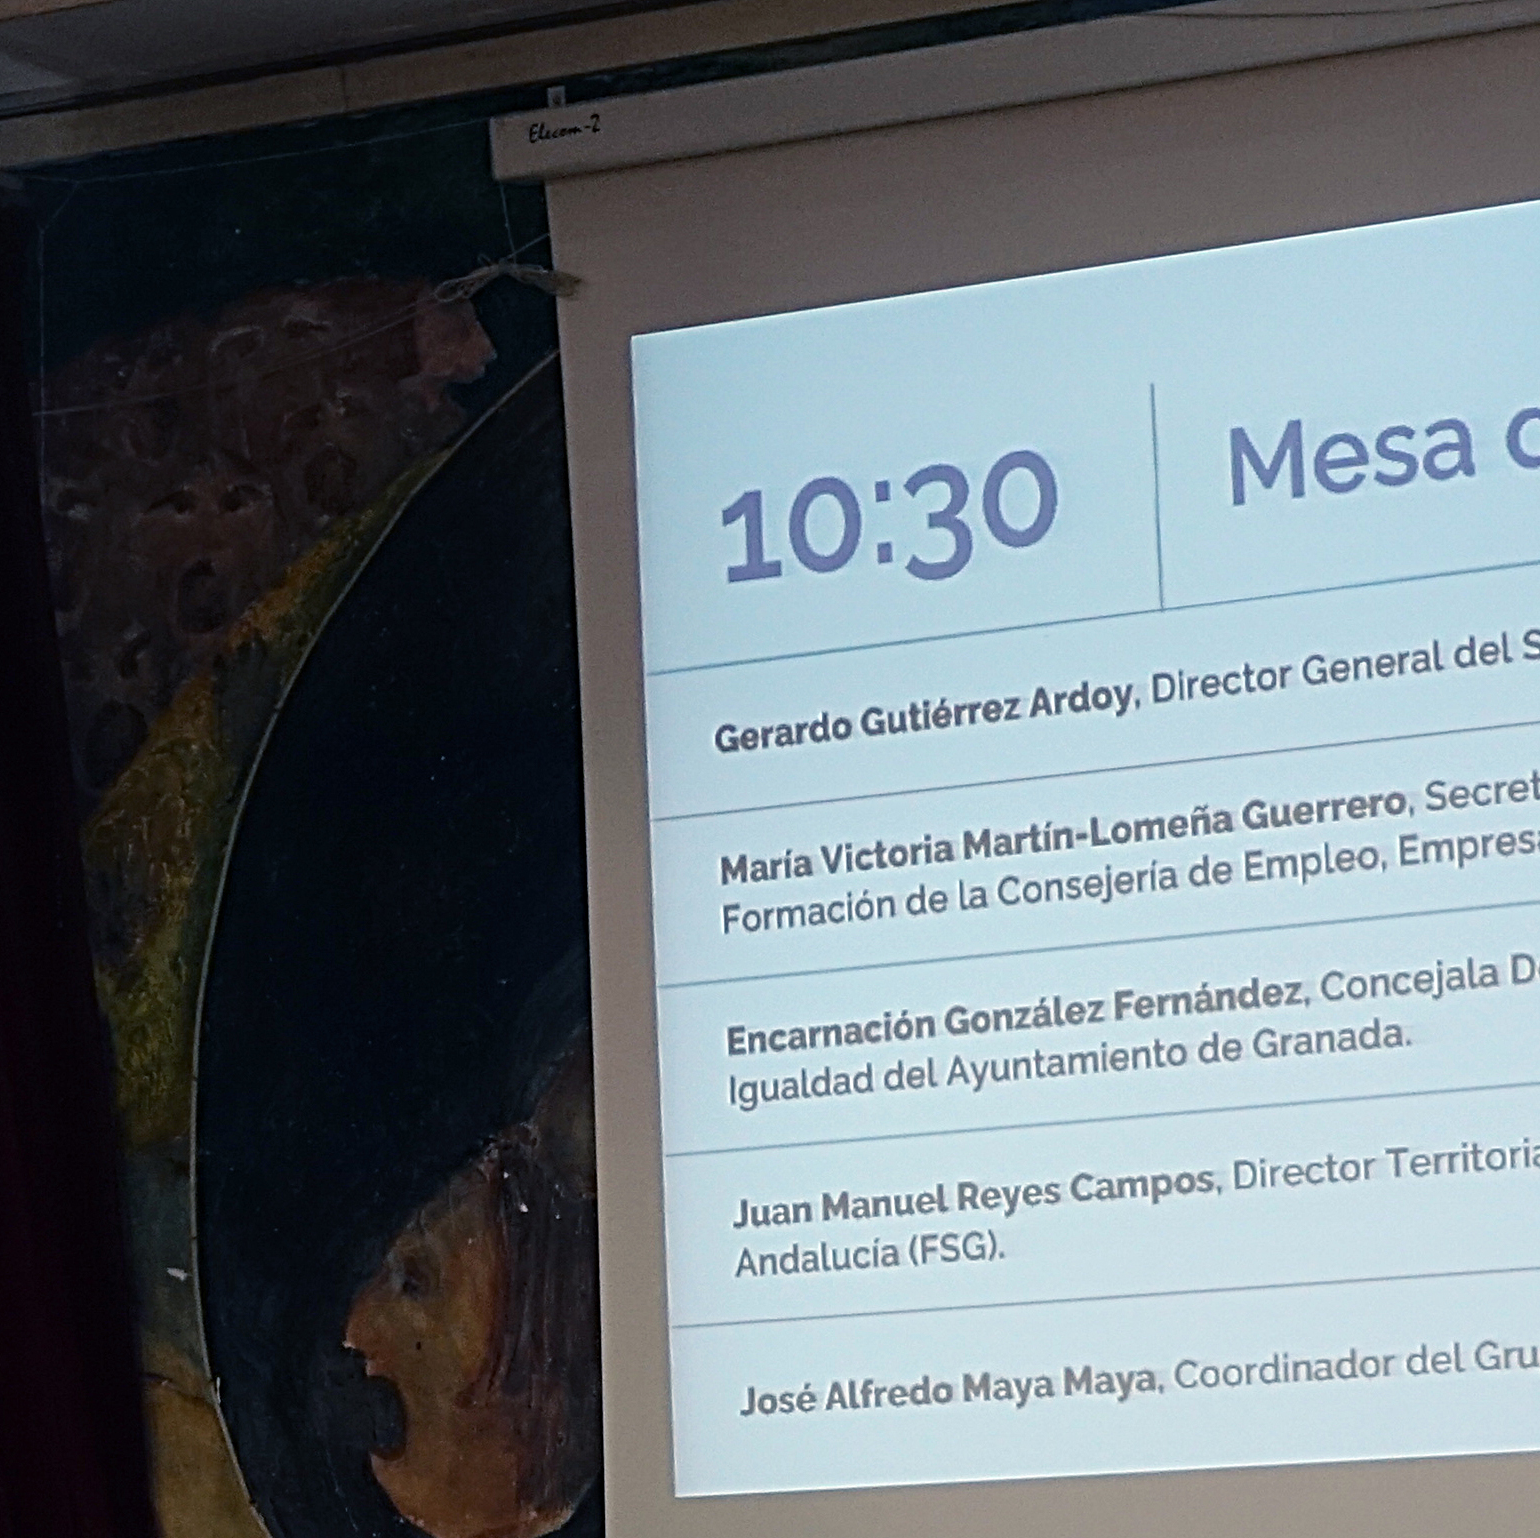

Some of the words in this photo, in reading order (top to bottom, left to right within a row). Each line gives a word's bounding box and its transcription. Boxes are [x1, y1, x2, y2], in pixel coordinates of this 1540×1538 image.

[1229, 417, 1477, 508] Mesa
[720, 448, 1059, 585] 10:30
[713, 710, 854, 755] Gerardo
[859, 696, 1023, 738] Gutiérrez
[1028, 679, 1142, 720] Ardoy,
[1151, 661, 1294, 705] Director
[1301, 638, 1446, 687] General
[1452, 630, 1515, 670] del
[720, 847, 815, 887] María
[819, 832, 957, 876] Victoria
[962, 803, 1236, 861] Martín-Lomeña
[1241, 790, 1416, 832] Guerrero,
[721, 887, 898, 936] Formación
[904, 882, 950, 917] de
[958, 878, 990, 912] la
[996, 858, 1180, 907] Consejería
[1187, 853, 1235, 889] de
[1243, 840, 1389, 886] Empleo,
[726, 1008, 937, 1058] Encarnación
[943, 994, 1106, 1037] González
[1113, 976, 1312, 1022] Fernández,
[1319, 955, 1501, 1003] Concejala
[729, 1061, 875, 1114] Igualdad
[882, 1056, 940, 1093] del
[945, 1037, 1189, 1094] Ayuntamiento
[1197, 1030, 1244, 1065] de
[1252, 1016, 1413, 1060] Granada.
[731, 1197, 814, 1231] Juan
[821, 1182, 951, 1223] Manuel
[956, 1180, 1063, 1220] Reyes
[1069, 1169, 1224, 1206] Campos,
[1232, 1153, 1378, 1191] Director
[734, 1236, 902, 1279] Andalucía
[907, 1228, 1006, 1268] (FSG).
[739, 1381, 819, 1419] José
[824, 1373, 955, 1412] Alfredo
[961, 1370, 1057, 1411] Maya
[1062, 1364, 1166, 1404] Maya,
[1173, 1346, 1398, 1390] Coordinador
[1405, 1341, 1467, 1377] del
